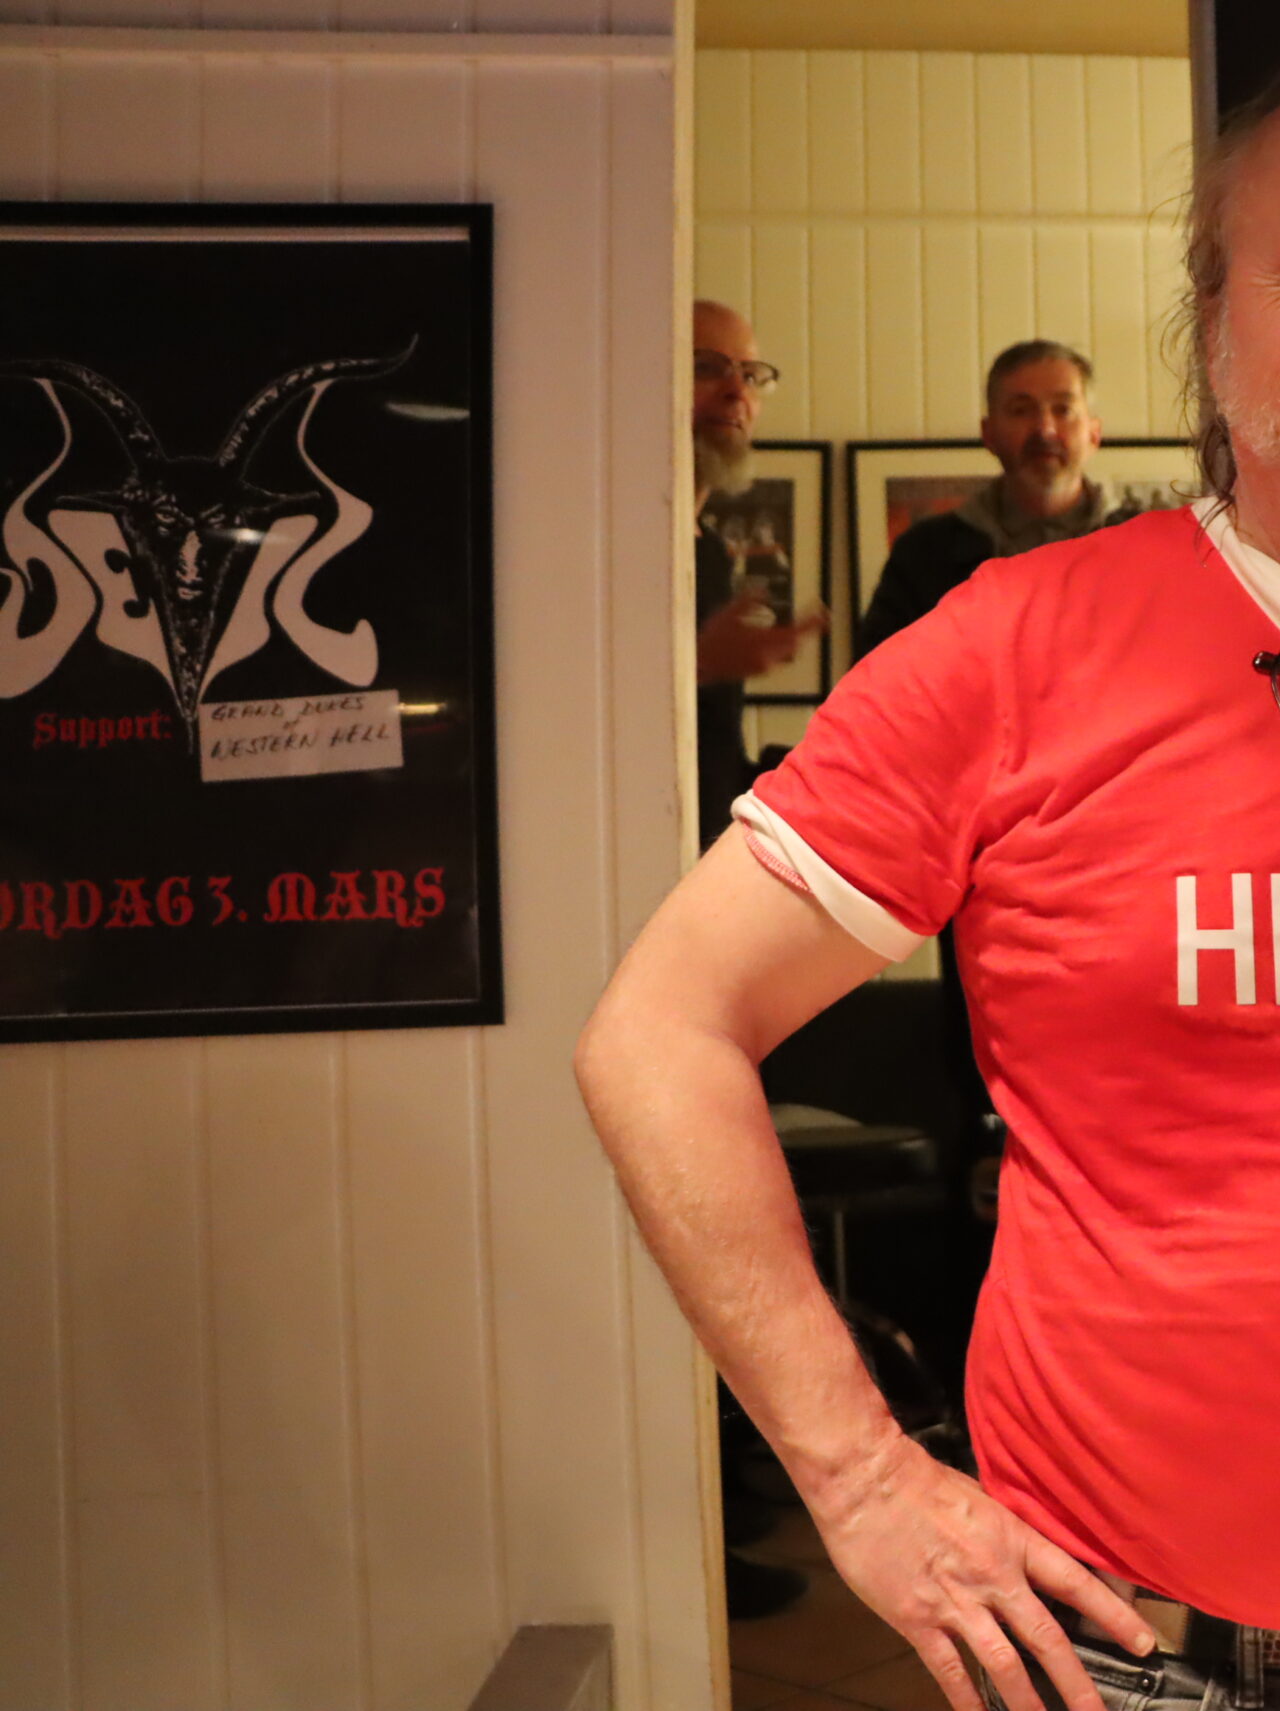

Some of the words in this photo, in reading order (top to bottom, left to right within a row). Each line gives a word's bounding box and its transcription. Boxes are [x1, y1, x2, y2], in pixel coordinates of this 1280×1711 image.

[33, 709, 173, 749] Support:
[210, 730, 320, 760] WESTERN
[329, 722, 390, 748] HELL
[207, 874, 248, 927] 3.
[263, 866, 446, 928] MARS
